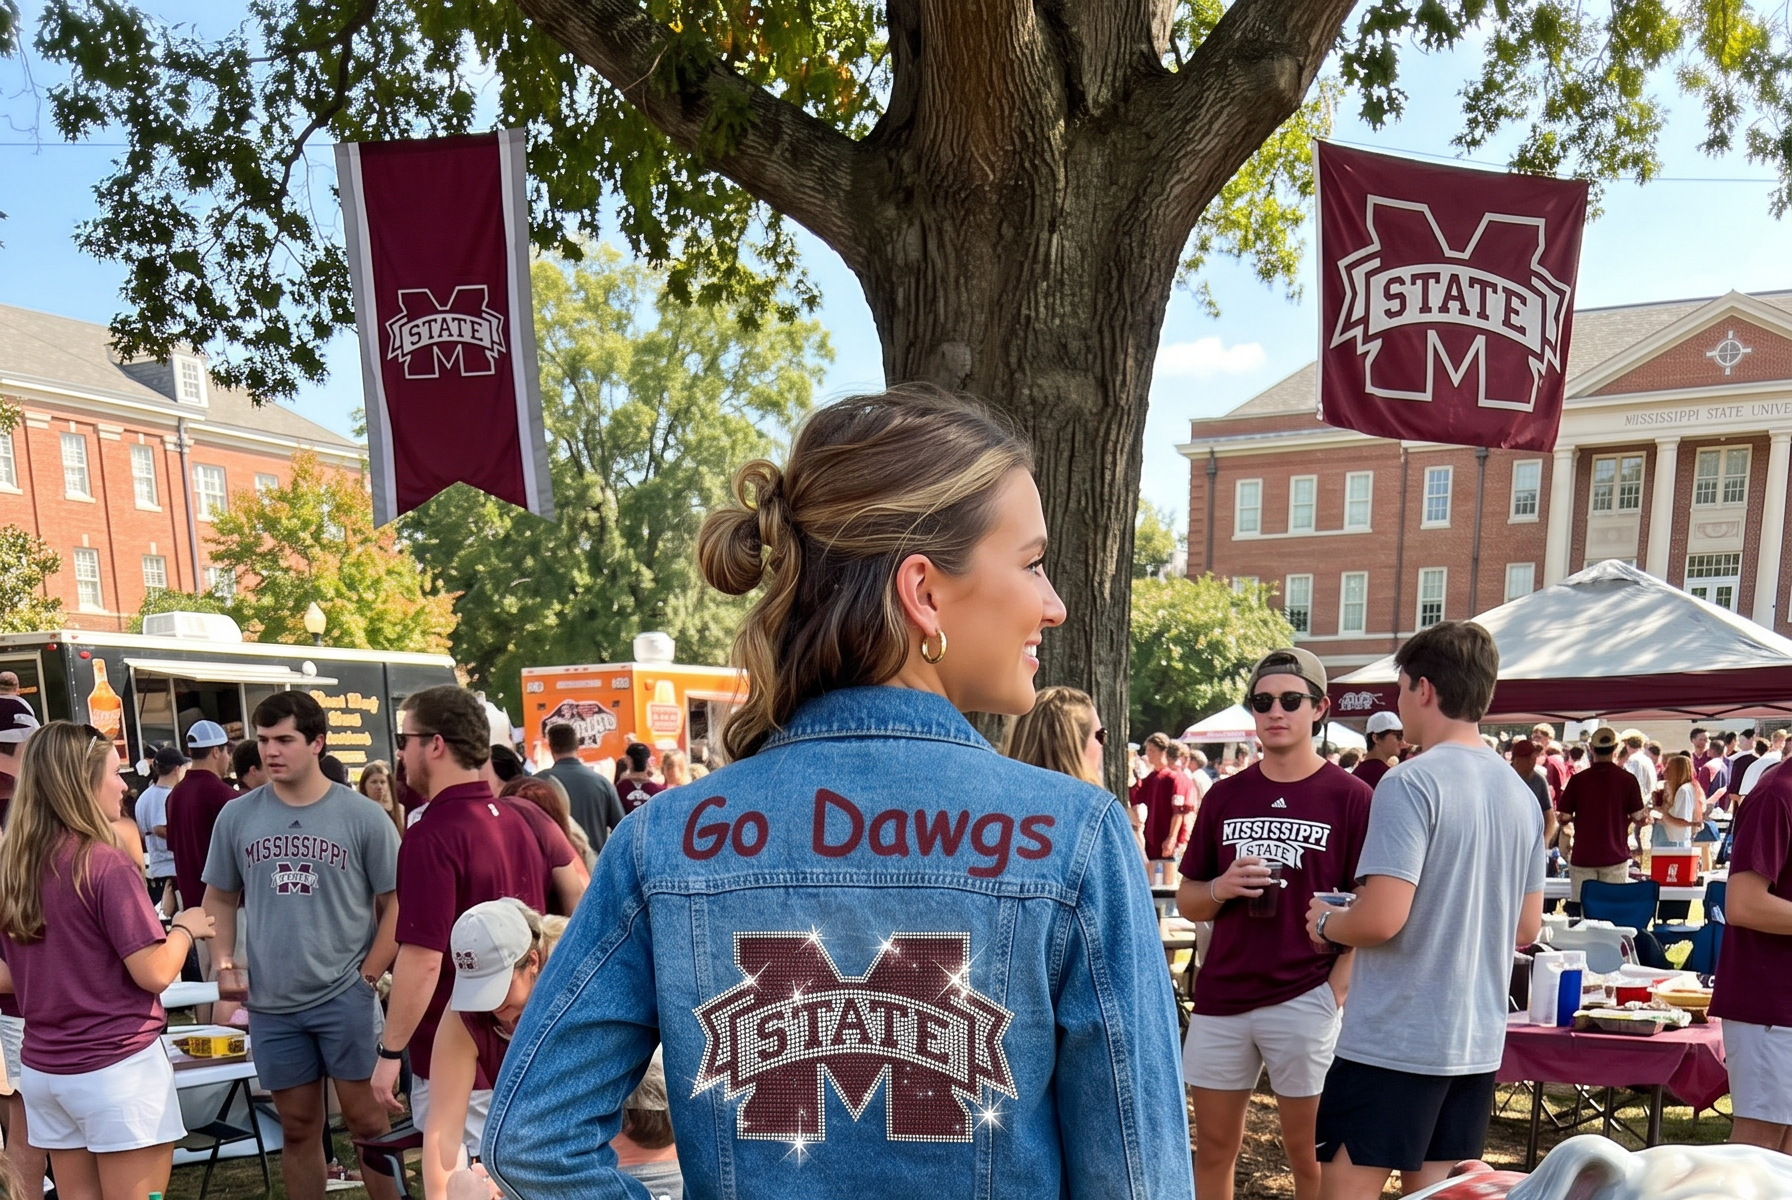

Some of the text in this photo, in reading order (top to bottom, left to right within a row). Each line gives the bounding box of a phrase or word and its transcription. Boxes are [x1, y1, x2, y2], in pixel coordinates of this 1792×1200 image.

[1382, 271, 1529, 339] STATE
[408, 316, 484, 346] STATE
[1706, 405, 1745, 420] STATE
[682, 787, 1056, 878] Go Dawgs
[1222, 820, 1331, 847] MISSISSIPPI
[245, 834, 348, 871] MISSISSIPPI
[1246, 843, 1290, 862] STATE
[755, 997, 951, 1065] STATE
